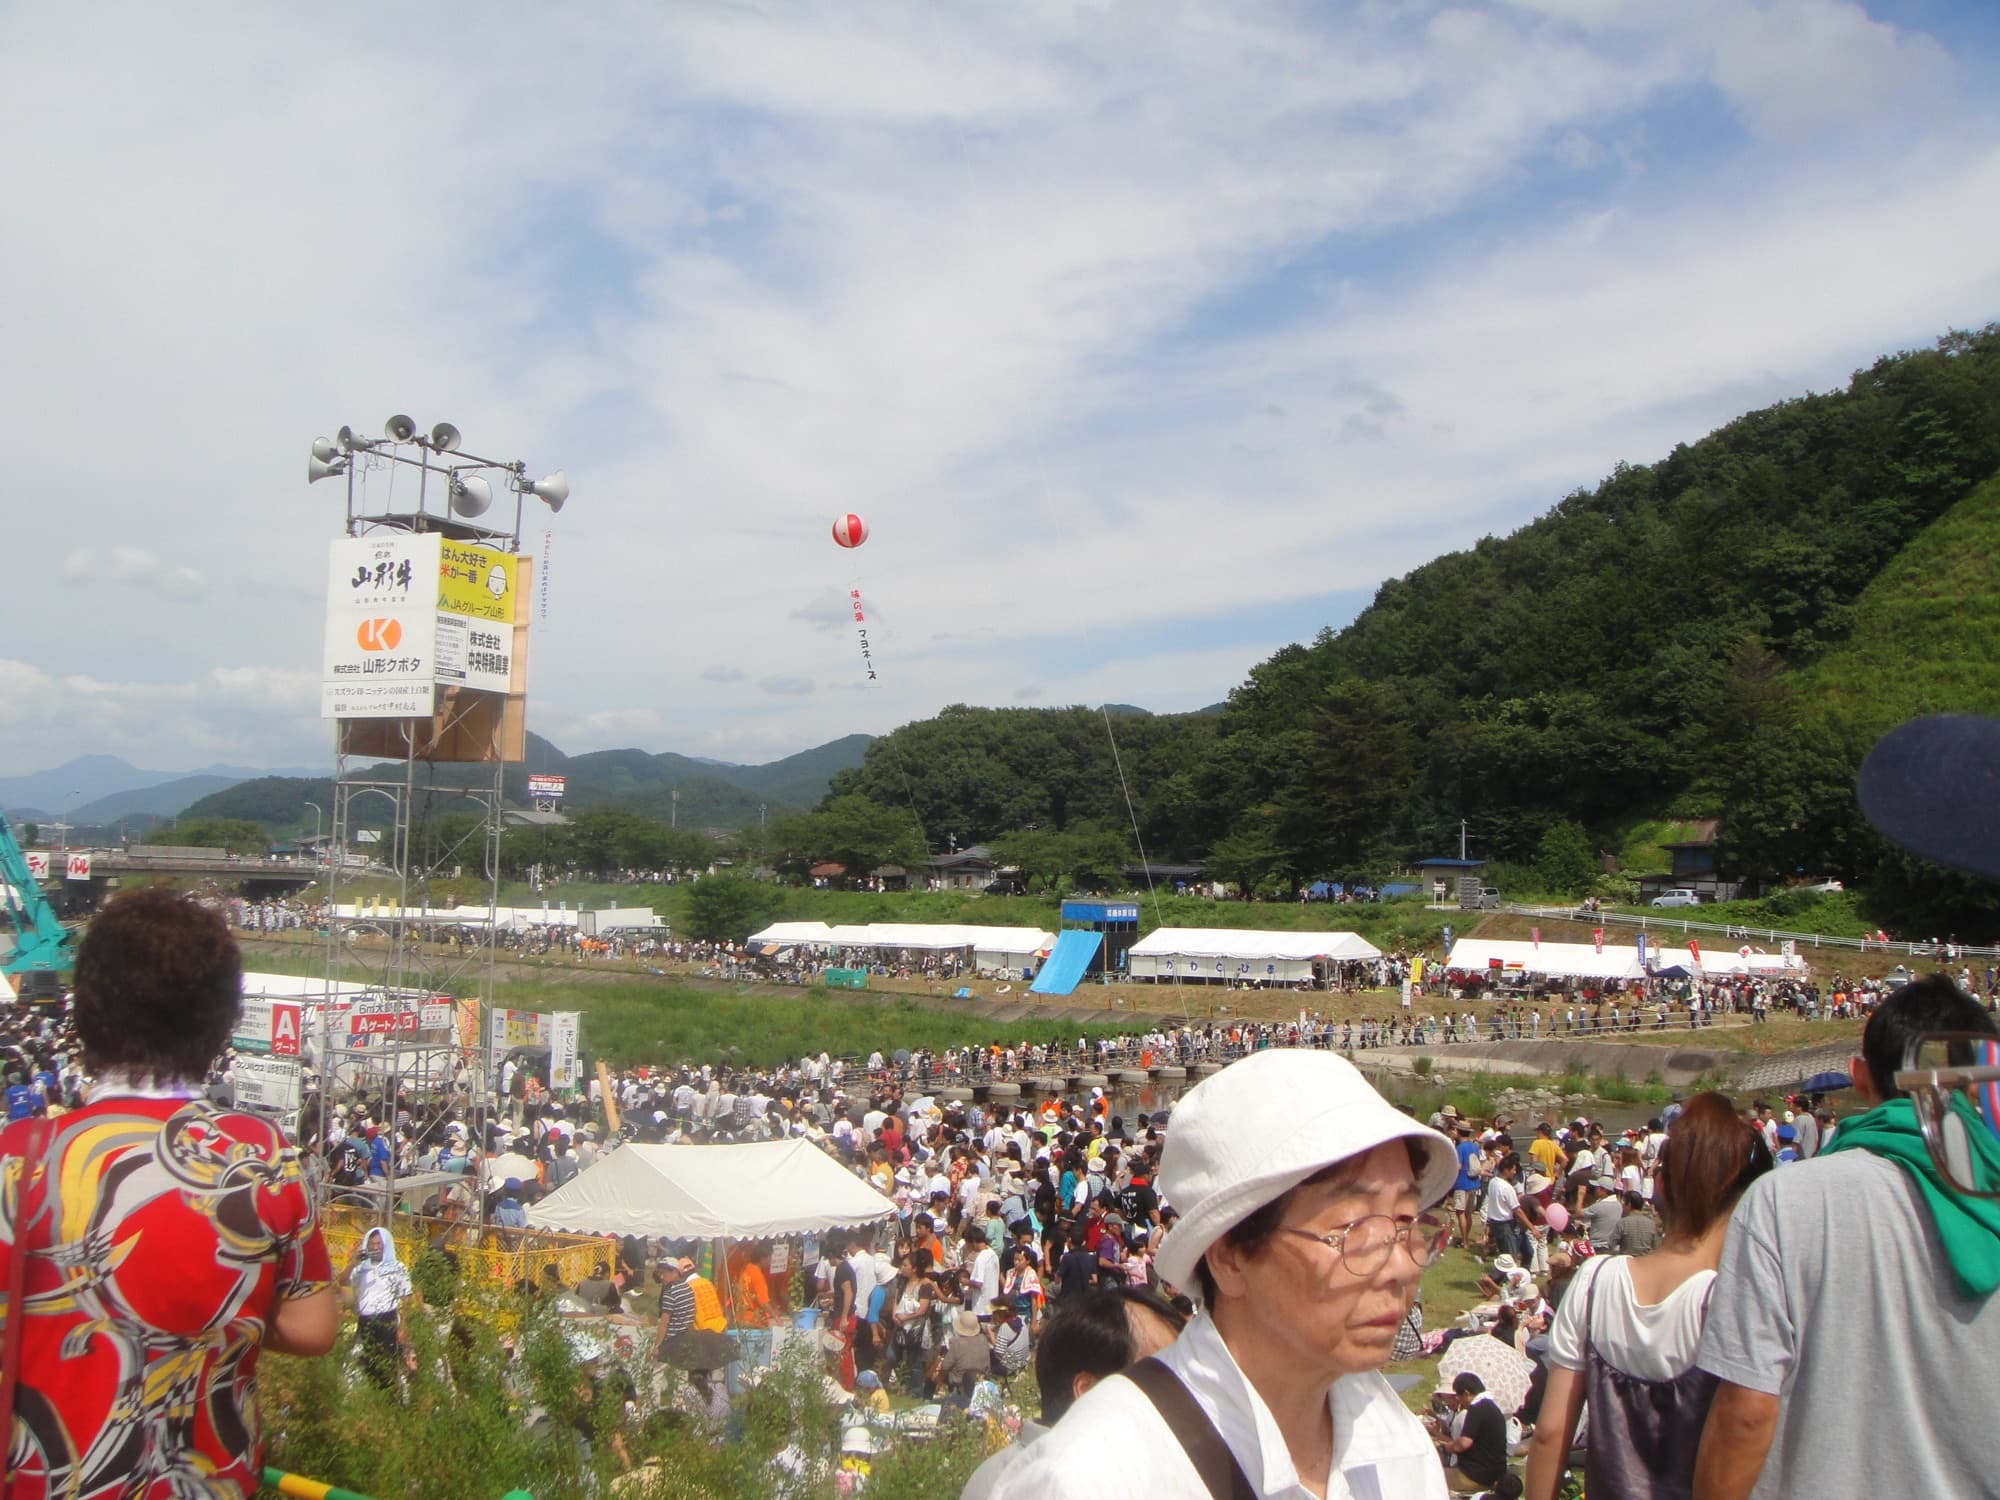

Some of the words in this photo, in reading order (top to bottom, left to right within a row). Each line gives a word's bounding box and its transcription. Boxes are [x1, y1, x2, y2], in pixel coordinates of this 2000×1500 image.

[351, 558, 413, 592] 山形牛
[470, 631, 501, 651] 株式会社
[333, 664, 361, 674] 株式会社
[362, 658, 421, 674] 山形クボタ
[275, 1009, 297, 1041] A
[275, 1041, 296, 1053] ゲート
